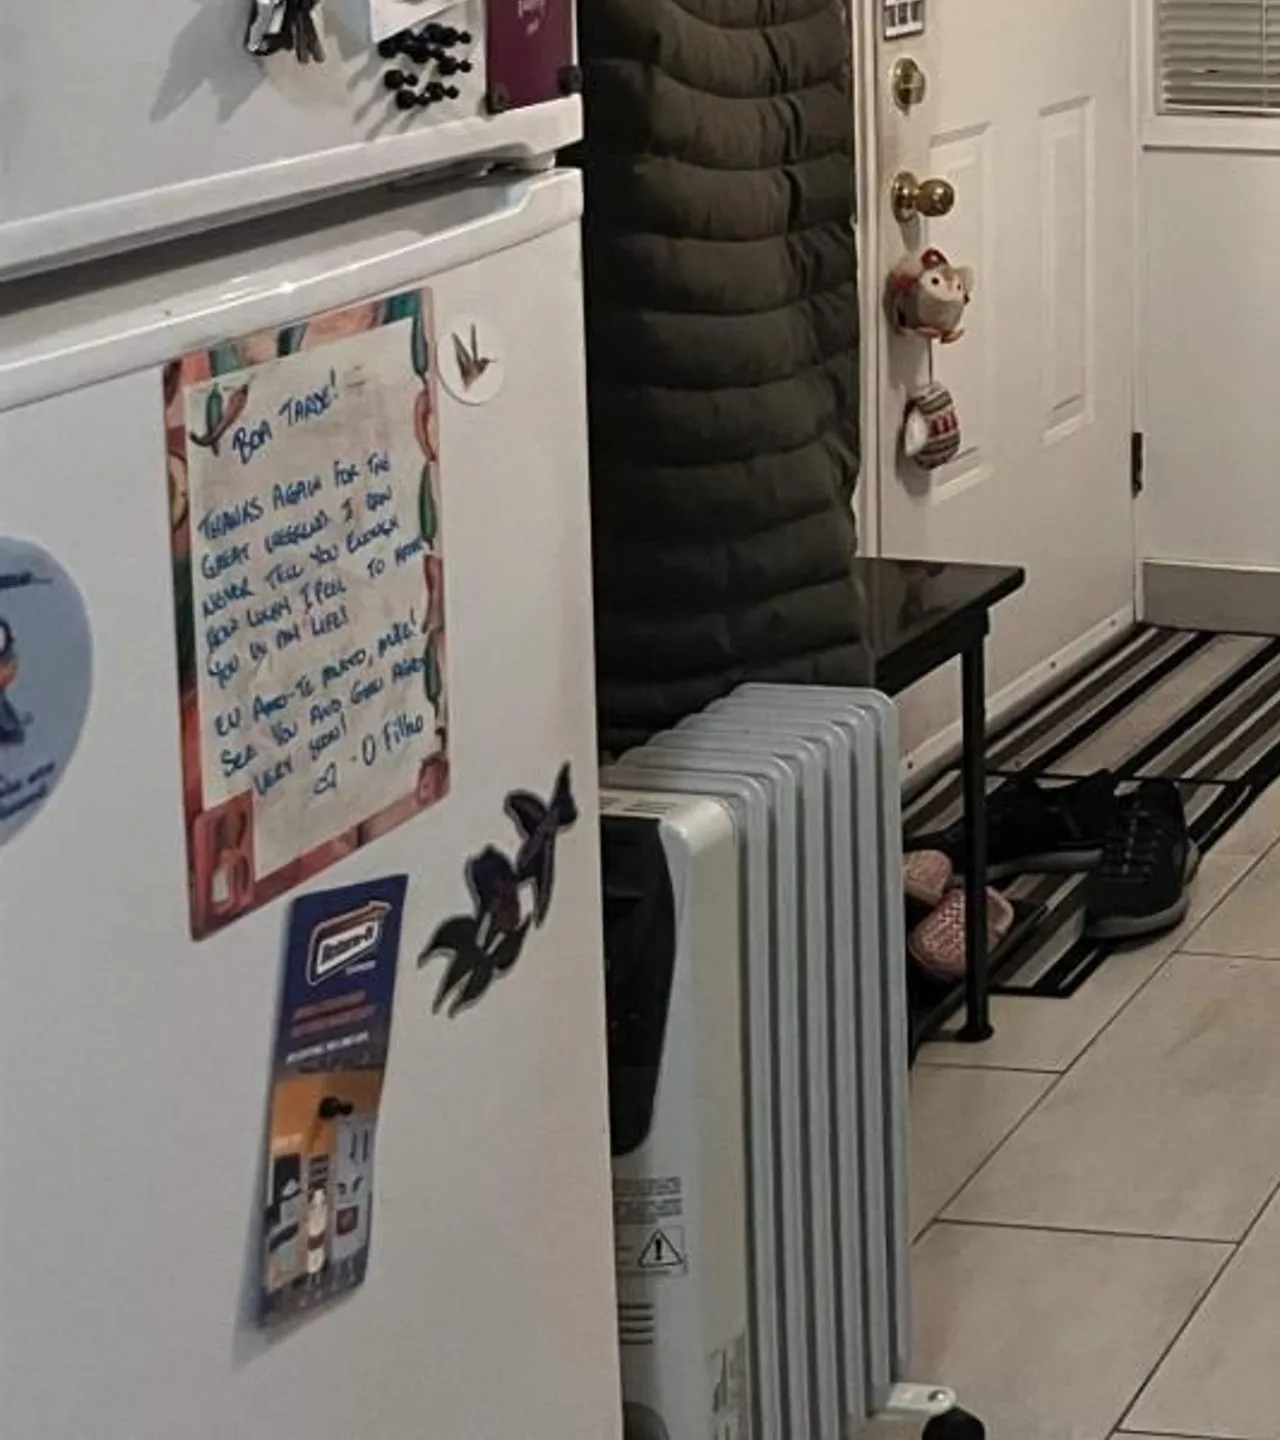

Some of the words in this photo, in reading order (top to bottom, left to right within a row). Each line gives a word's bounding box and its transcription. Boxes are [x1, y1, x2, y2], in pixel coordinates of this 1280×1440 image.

[232, 419, 272, 464] BOA
[197, 496, 264, 540] THANKS
[273, 475, 322, 509] AGAIN
[333, 460, 360, 487] FOR
[265, 563, 303, 590] TELL
[309, 544, 339, 567] YOU
[315, 577, 346, 606] FEEL
[367, 558, 385, 578] TO
[207, 652, 238, 689] YOU
[221, 745, 257, 777] SEE
[271, 722, 298, 746] YOU
[254, 753, 293, 795] VERY
